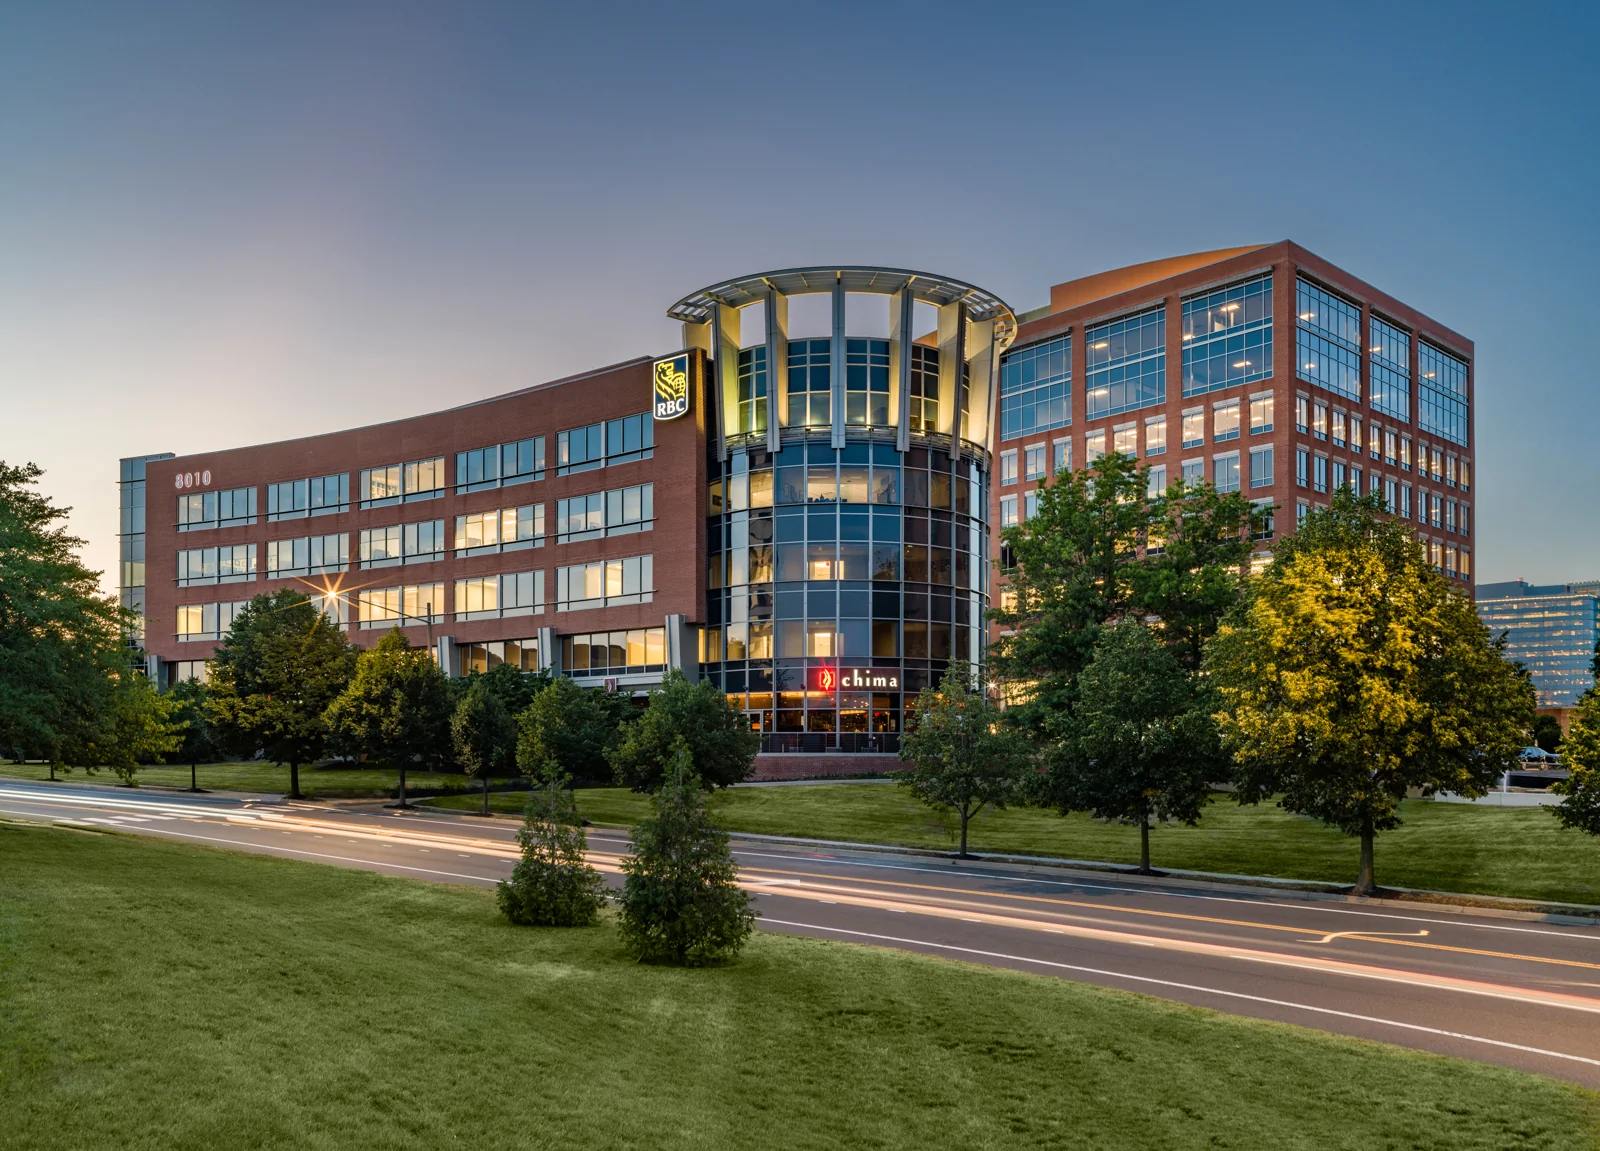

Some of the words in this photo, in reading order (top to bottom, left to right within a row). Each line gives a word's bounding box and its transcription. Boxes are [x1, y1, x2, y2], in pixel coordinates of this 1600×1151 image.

[657, 398, 685, 416] RBC
[175, 470, 211, 489] 8010
[841, 669, 898, 687] chima
